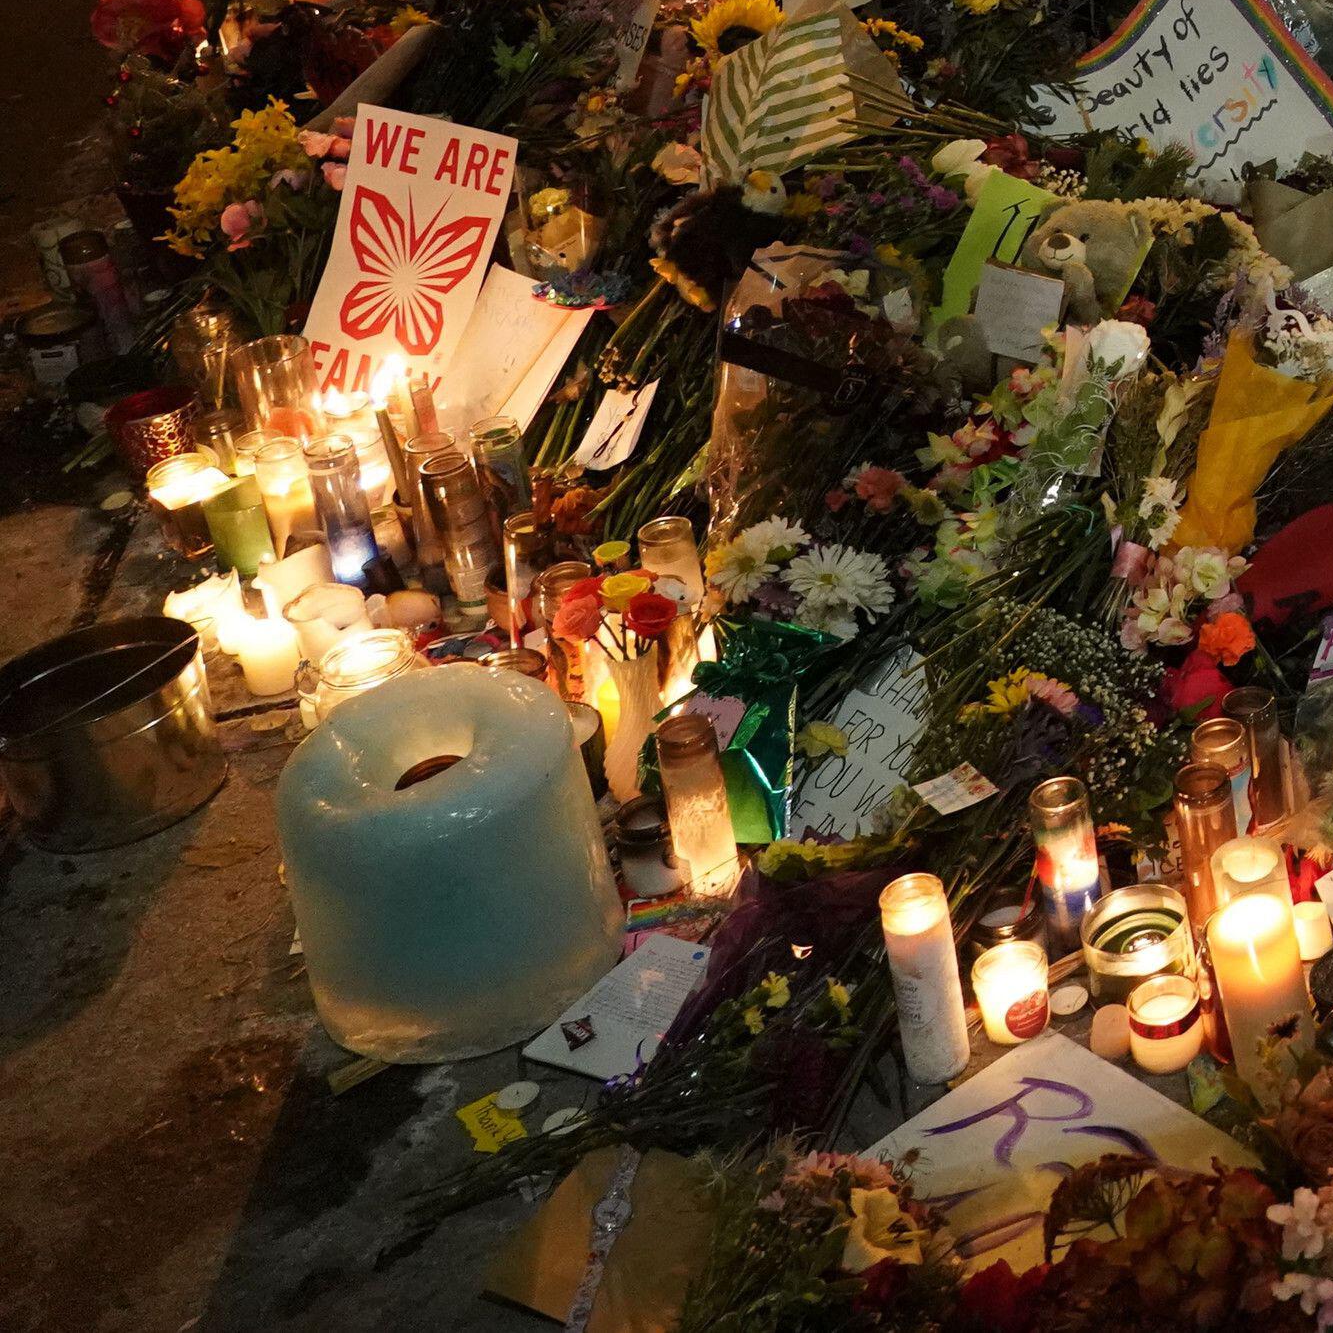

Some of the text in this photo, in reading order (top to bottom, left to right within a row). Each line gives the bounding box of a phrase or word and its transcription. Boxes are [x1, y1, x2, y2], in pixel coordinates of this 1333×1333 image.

[1179, 44, 1230, 103] lies
[366, 118, 510, 197] WE ARE
[839, 709, 886, 754] FOR
